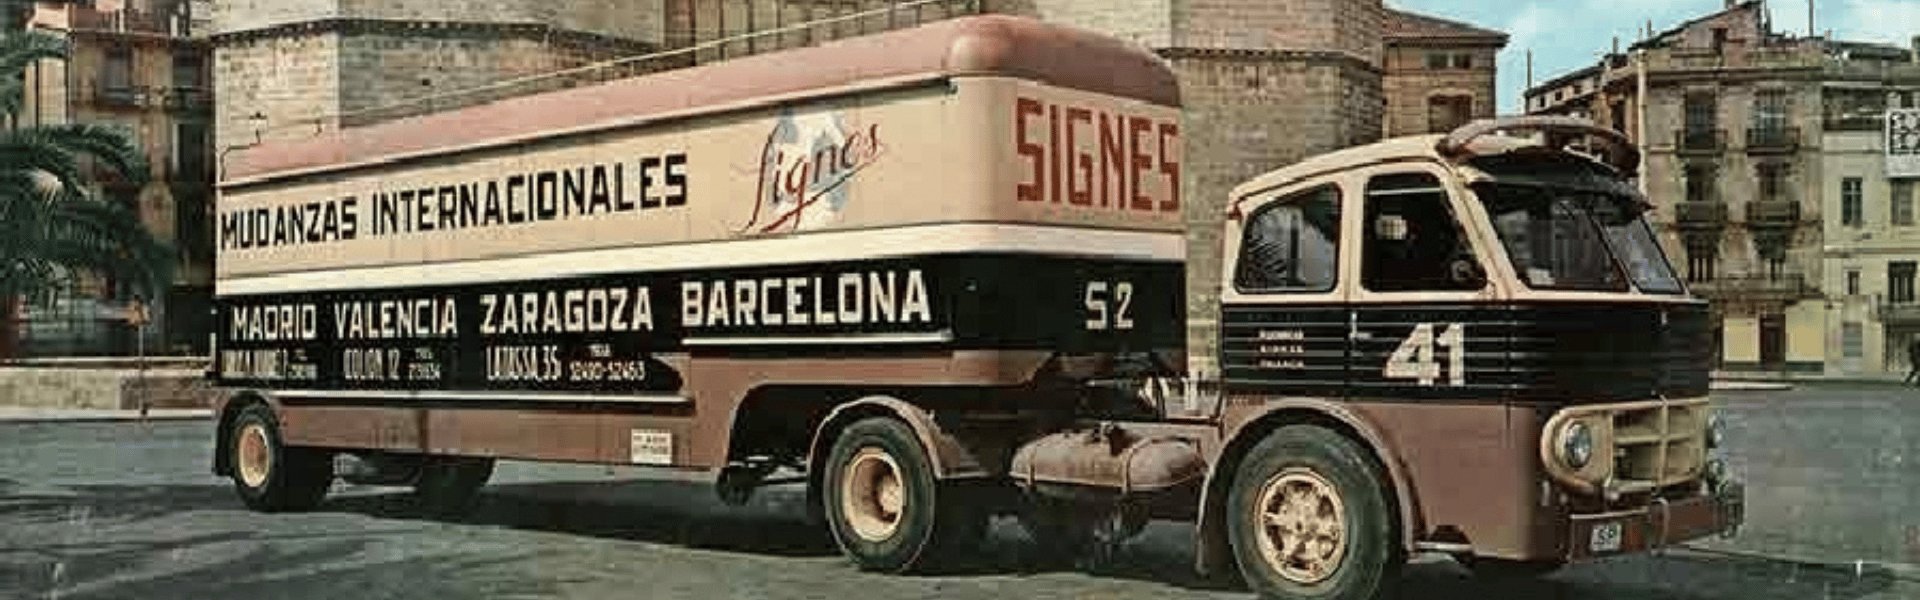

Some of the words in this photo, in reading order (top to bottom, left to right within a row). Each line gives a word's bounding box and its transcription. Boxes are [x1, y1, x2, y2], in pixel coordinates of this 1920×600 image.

[221, 196, 358, 249] MUDANZAS
[372, 154, 688, 235] INTERNACIONALES
[738, 122, 882, 233] Signes
[1016, 98, 1180, 212] SIGNES
[231, 304, 317, 340] MADRID
[335, 297, 458, 339] VALENCIA
[480, 286, 654, 334] ZARAGOZA
[682, 270, 931, 327] BARCELONA
[1382, 322, 1465, 387] 41
